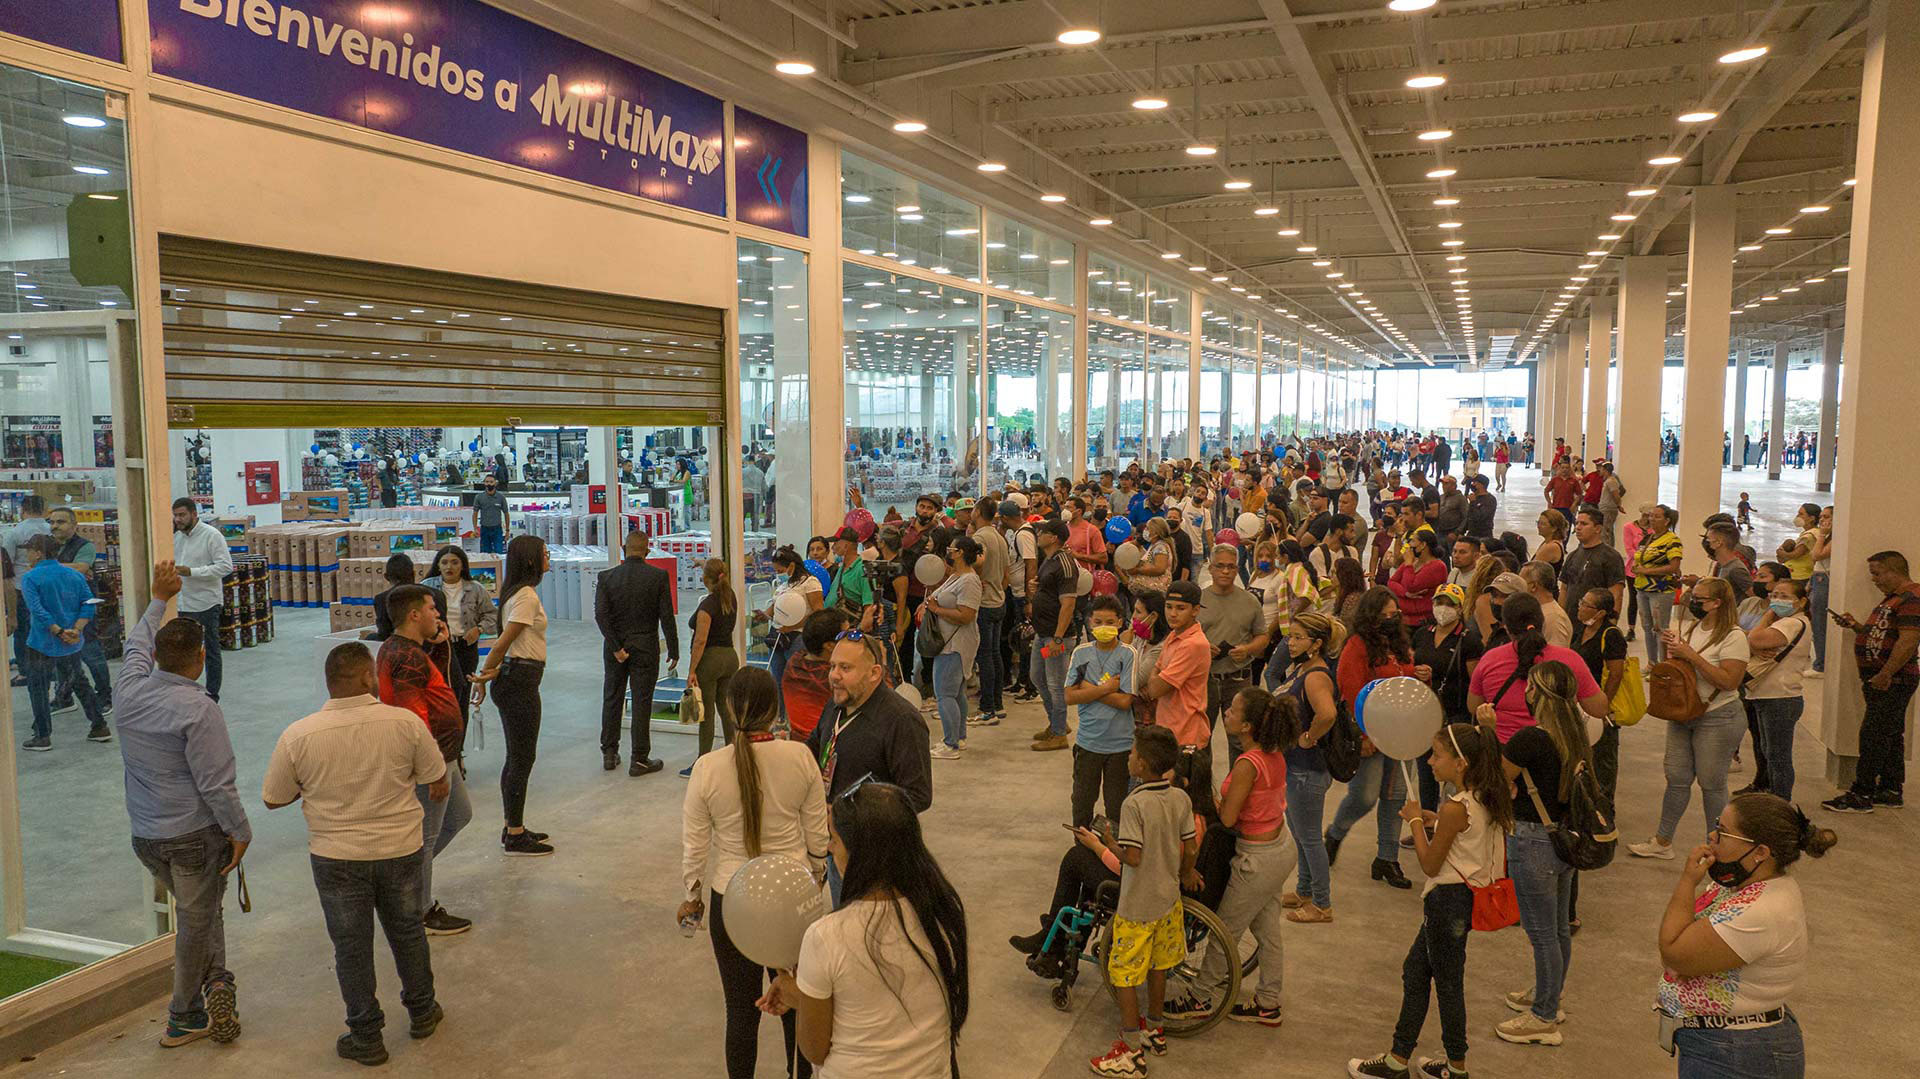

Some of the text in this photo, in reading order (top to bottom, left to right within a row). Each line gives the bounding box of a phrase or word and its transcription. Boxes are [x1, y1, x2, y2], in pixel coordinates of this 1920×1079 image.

[494, 79, 518, 112] a
[541, 73, 708, 175] MultiMax
[567, 139, 693, 185] STORE
